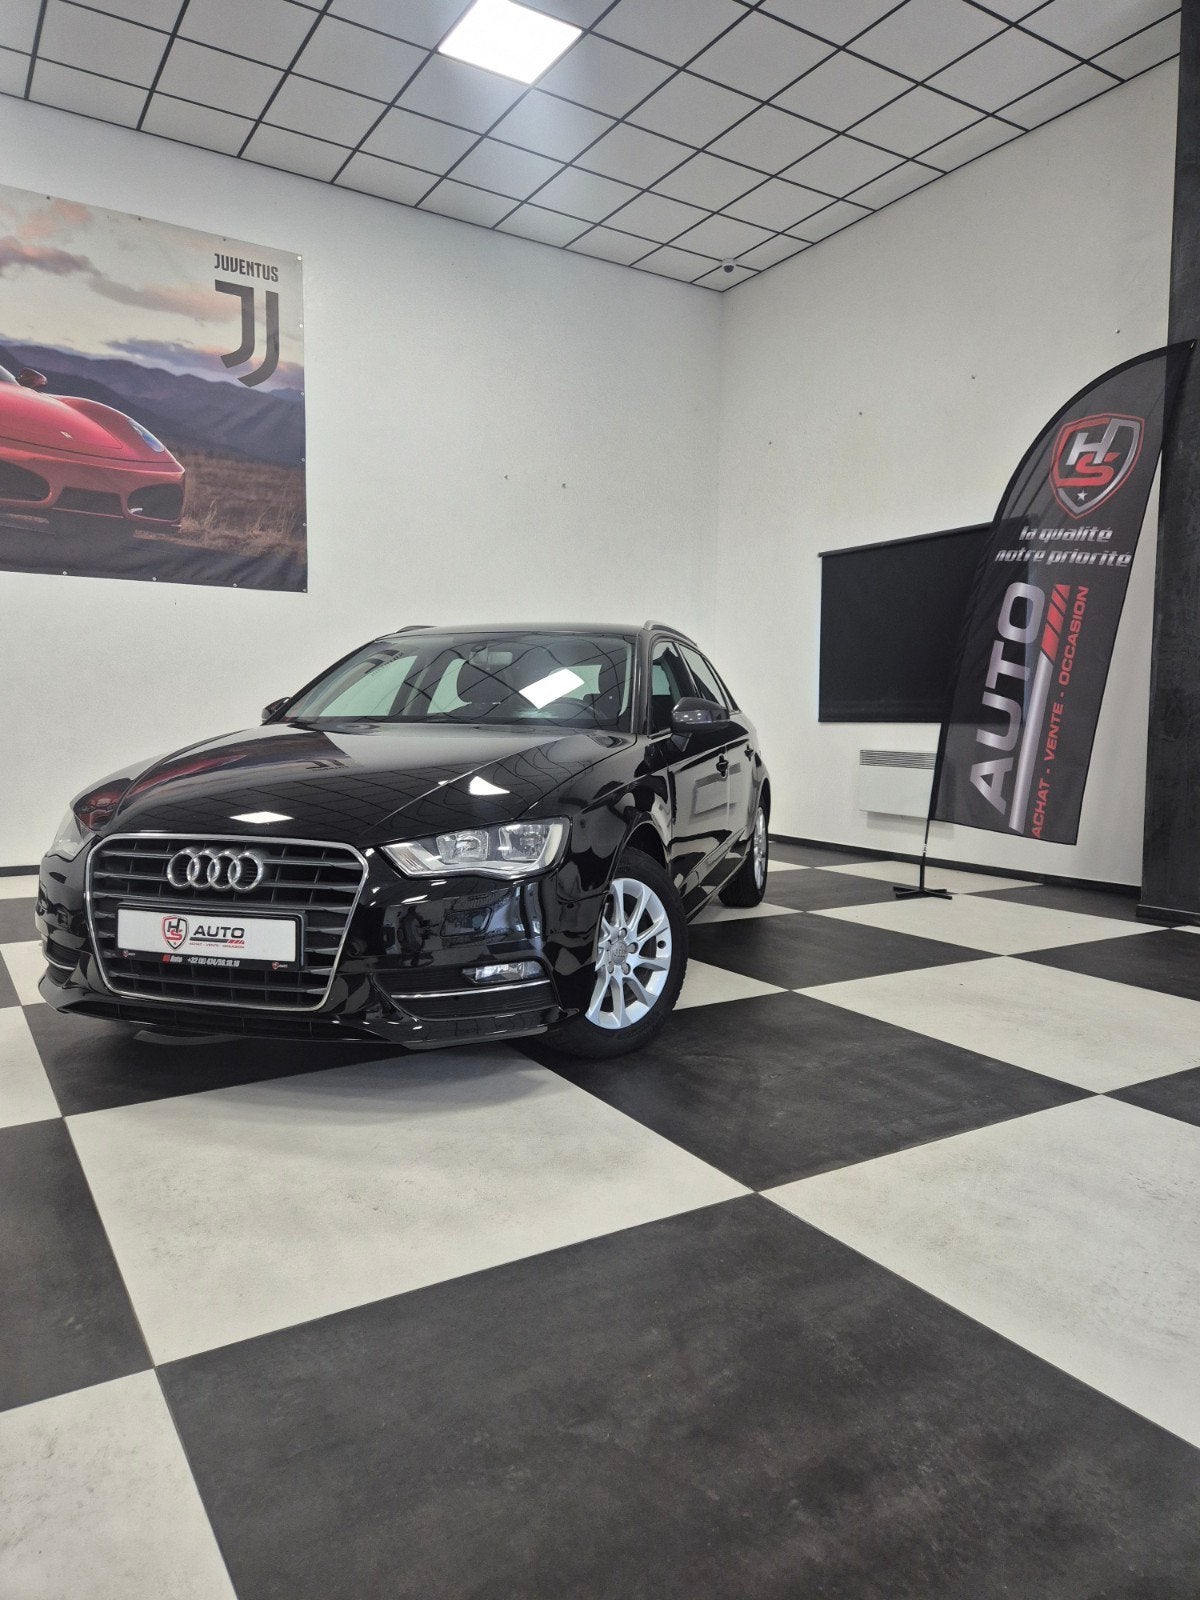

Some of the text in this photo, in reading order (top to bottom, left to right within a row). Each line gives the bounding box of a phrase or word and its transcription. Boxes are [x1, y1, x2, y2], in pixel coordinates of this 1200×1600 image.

[214, 253, 279, 282] JUVENTUS
[1019, 525, 1114, 544] la qualité
[994, 547, 1133, 568] notre priorité
[969, 581, 1046, 816] AUTO
[1030, 777, 1050, 839] ACHAT
[1043, 702, 1065, 762] VENTE
[1058, 585, 1090, 686] OCCASION
[193, 925, 245, 939] AUTO
